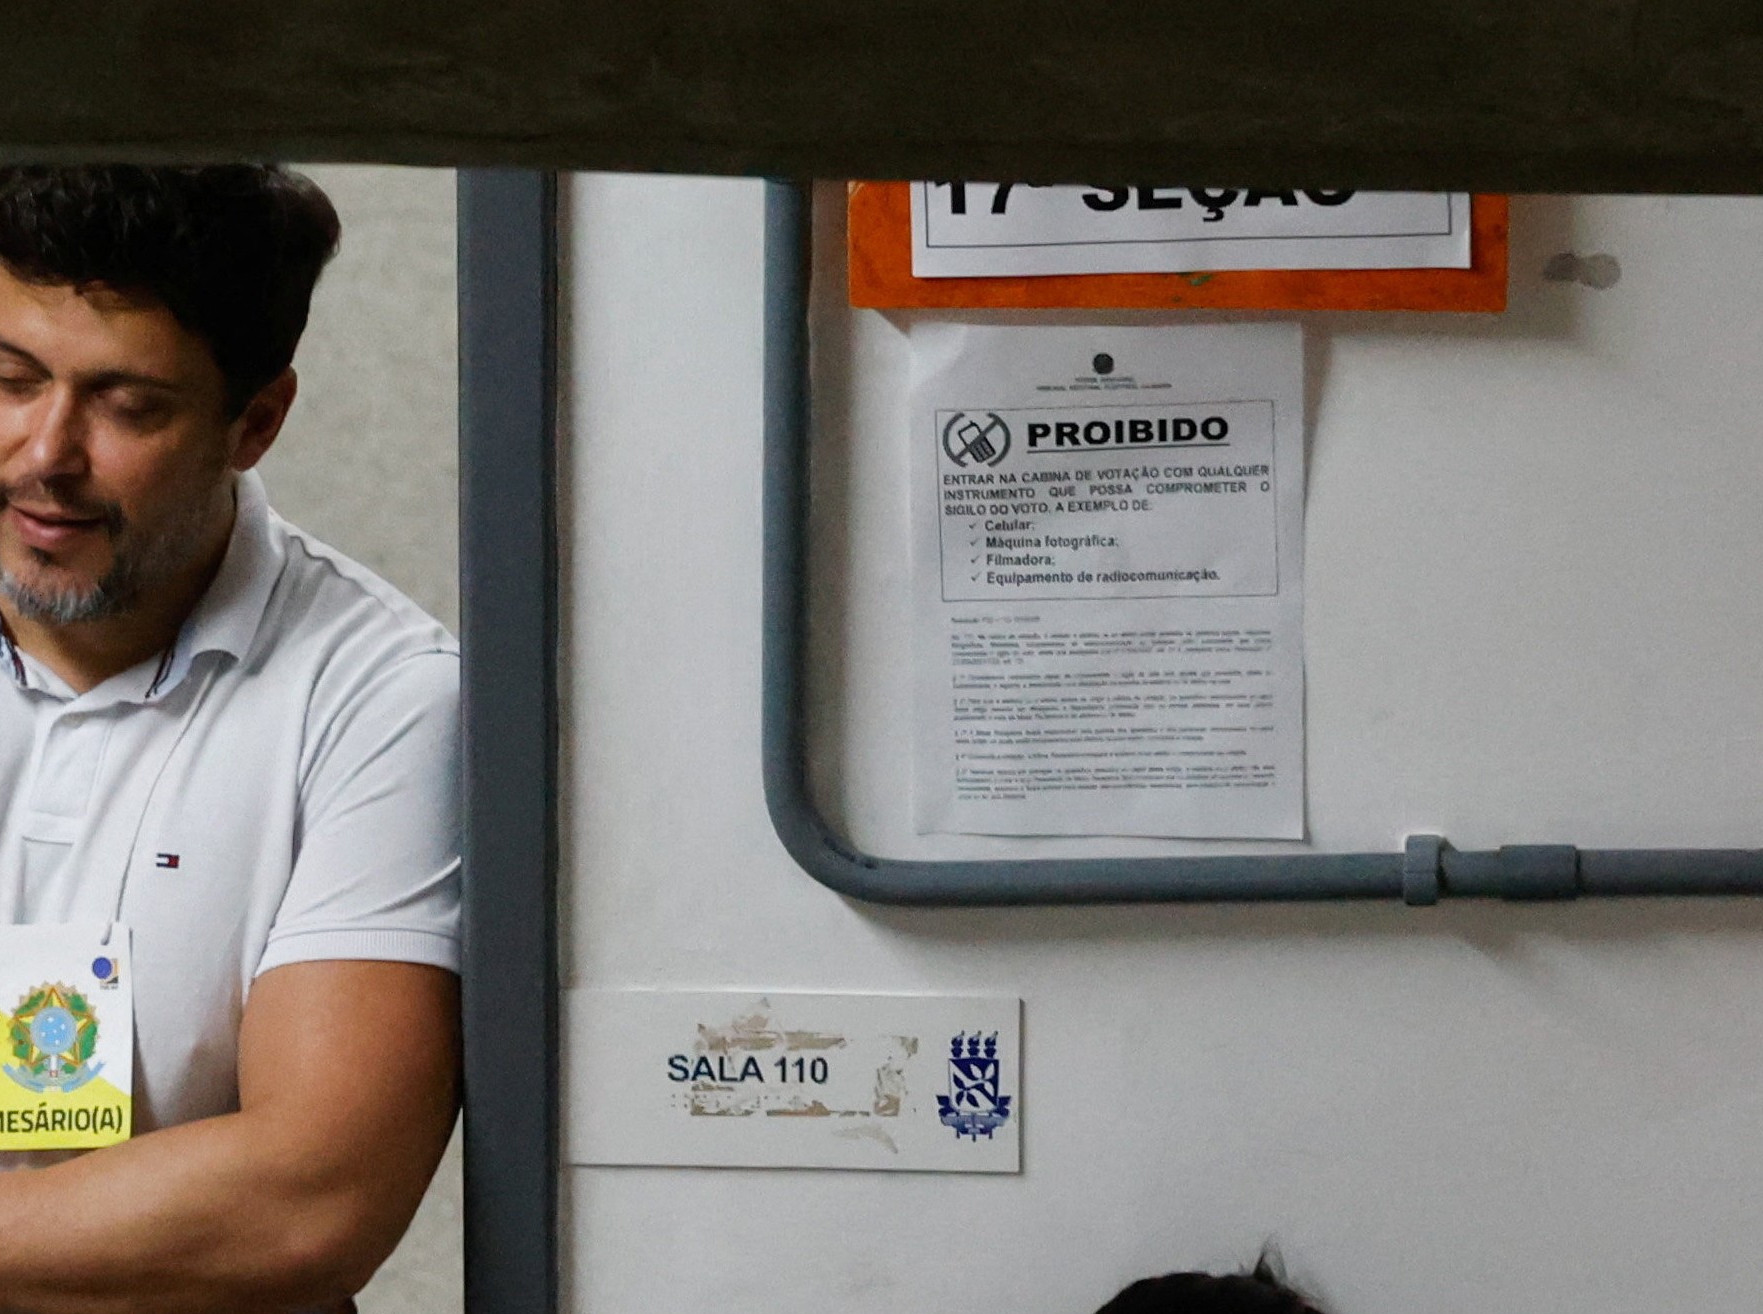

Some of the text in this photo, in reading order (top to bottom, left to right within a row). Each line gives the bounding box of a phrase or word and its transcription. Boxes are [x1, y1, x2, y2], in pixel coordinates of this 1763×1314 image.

[933, 181, 1358, 222] 17 SEÇ
[1027, 416, 1229, 447] PROIBIDO
[944, 465, 1270, 485] ENTRAR NA CABINA DE VOTAÇÃO COM QUALQUER
[944, 481, 1270, 500] INSTRUMENTO QUE POSSA COMPROMETER O
[945, 504, 986, 516] SIGILO
[990, 504, 1009, 515] DO
[1055, 502, 1065, 512] A
[1068, 500, 1129, 513] EXEMPLO
[986, 534, 1119, 551] Máquina fotográfica;
[986, 553, 1056, 566] Filmadora;
[987, 568, 1221, 587] Equipamento de radiocomunicação.
[668, 1054, 828, 1084] SALA 110
